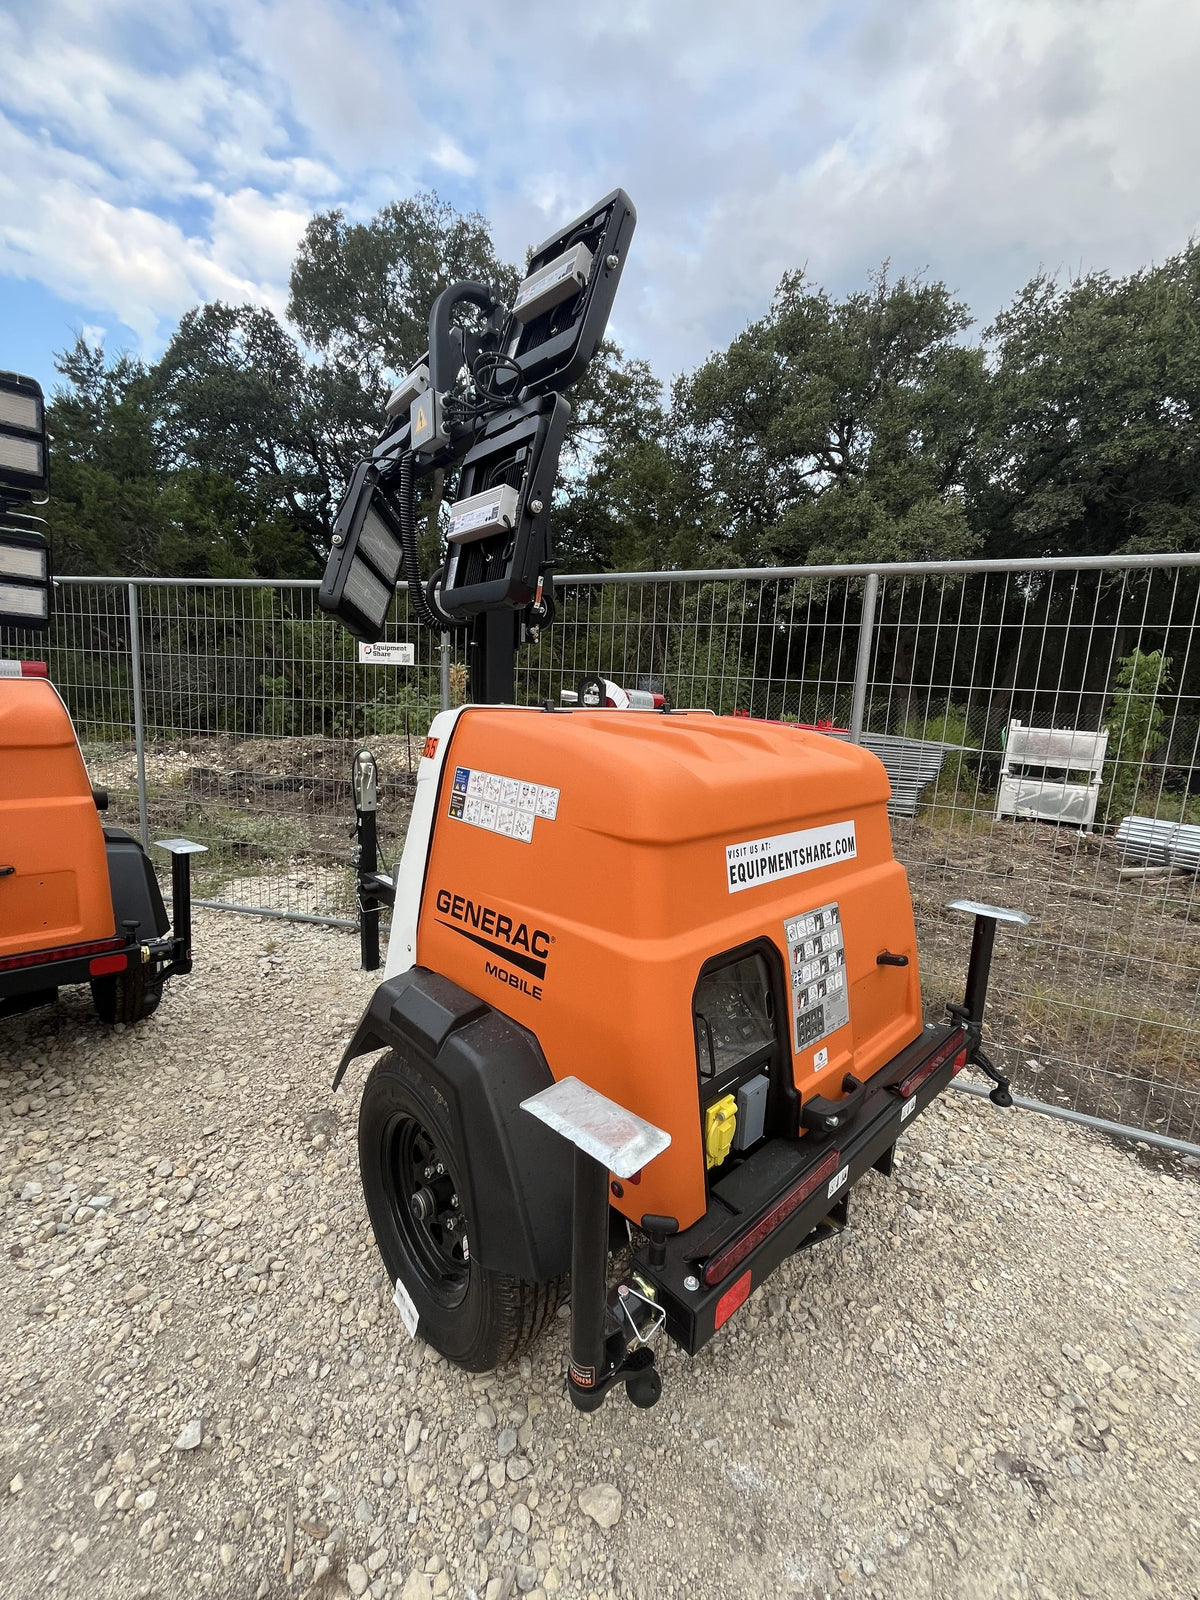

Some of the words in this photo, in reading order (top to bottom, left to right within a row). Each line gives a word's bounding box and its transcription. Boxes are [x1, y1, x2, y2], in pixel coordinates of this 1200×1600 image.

[373, 644, 407, 652] Equipment
[727, 847, 747, 859] VISIT
[749, 844, 759, 855] US
[761, 842, 771, 851] AT:
[729, 836, 855, 885] EQUIPMENTSHARE.COM
[436, 889, 550, 959] GENERAC
[485, 961, 543, 1001] MOBILE
